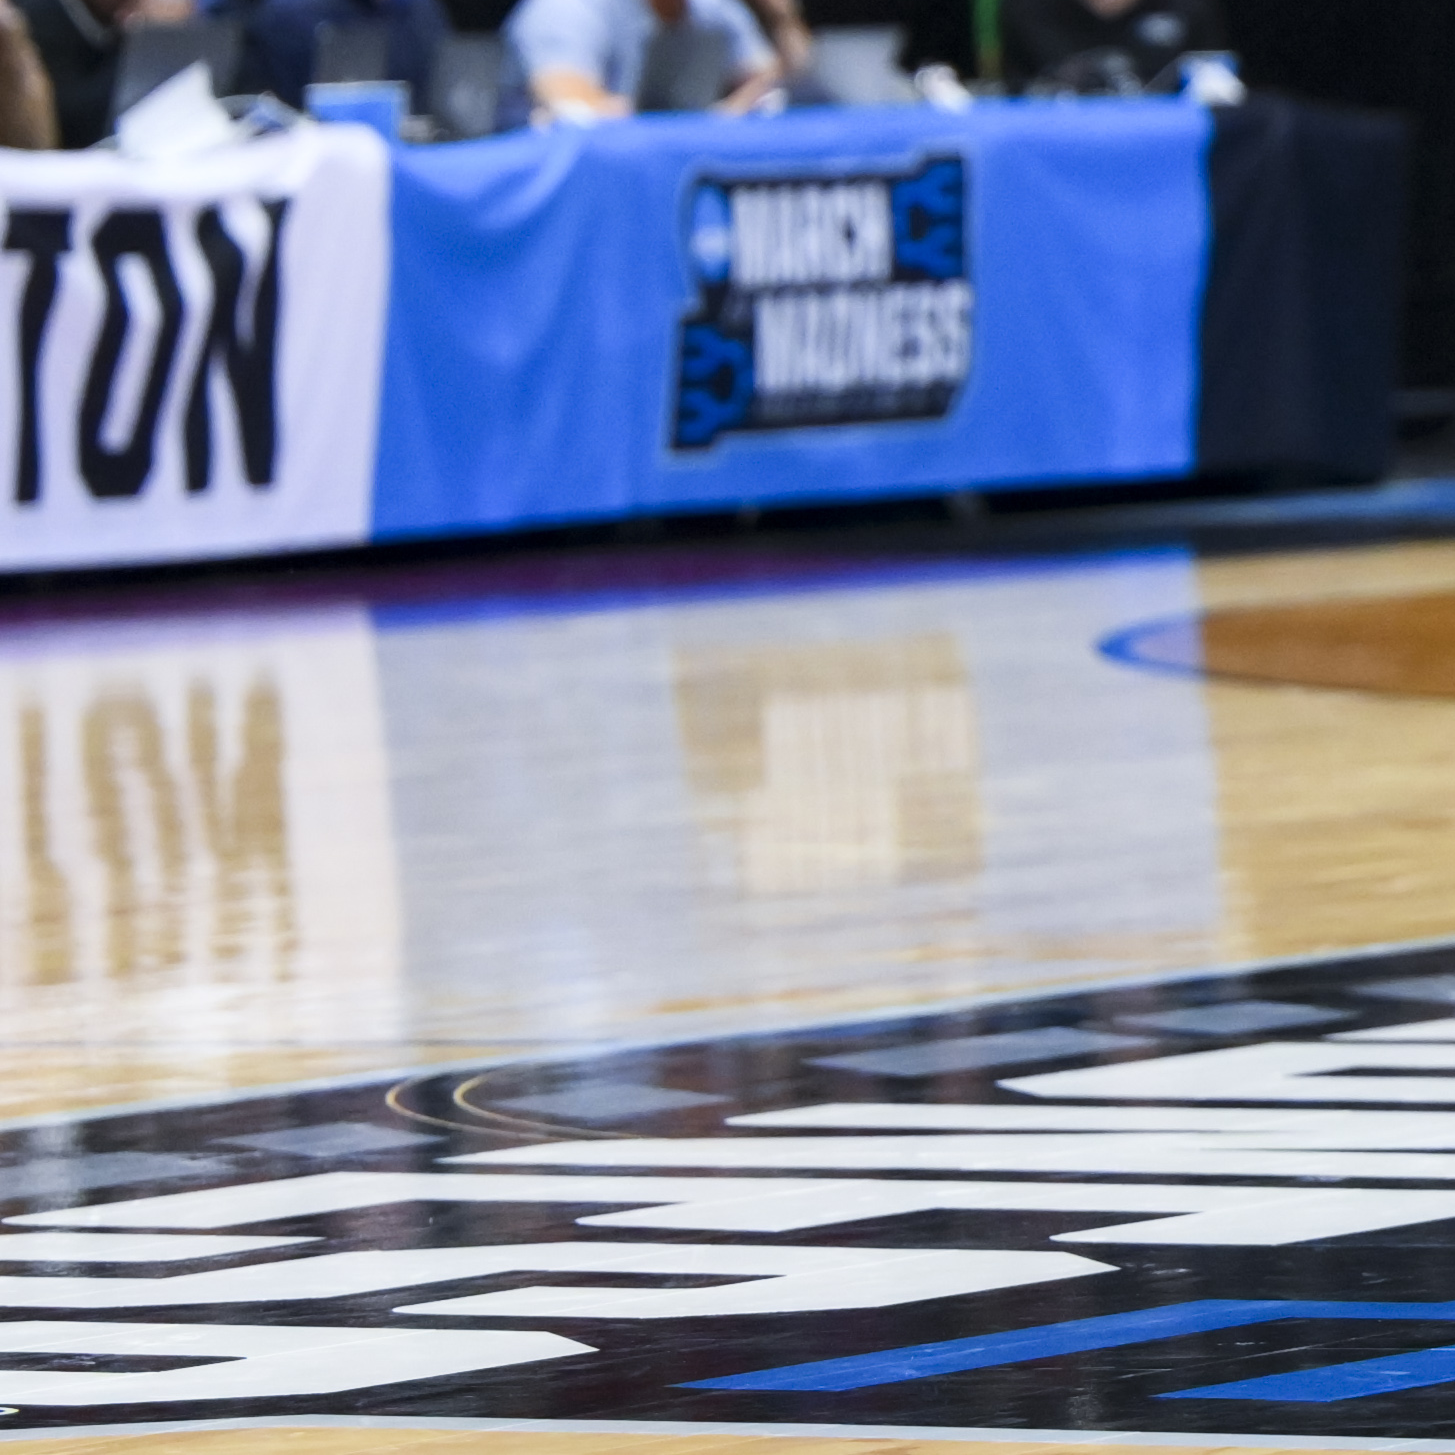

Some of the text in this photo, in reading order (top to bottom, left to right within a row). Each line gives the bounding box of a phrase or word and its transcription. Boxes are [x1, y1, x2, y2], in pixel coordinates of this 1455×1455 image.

[729, 181, 893, 290] MARCH
[2, 199, 292, 502] TON
[753, 282, 974, 396] MADNESS
